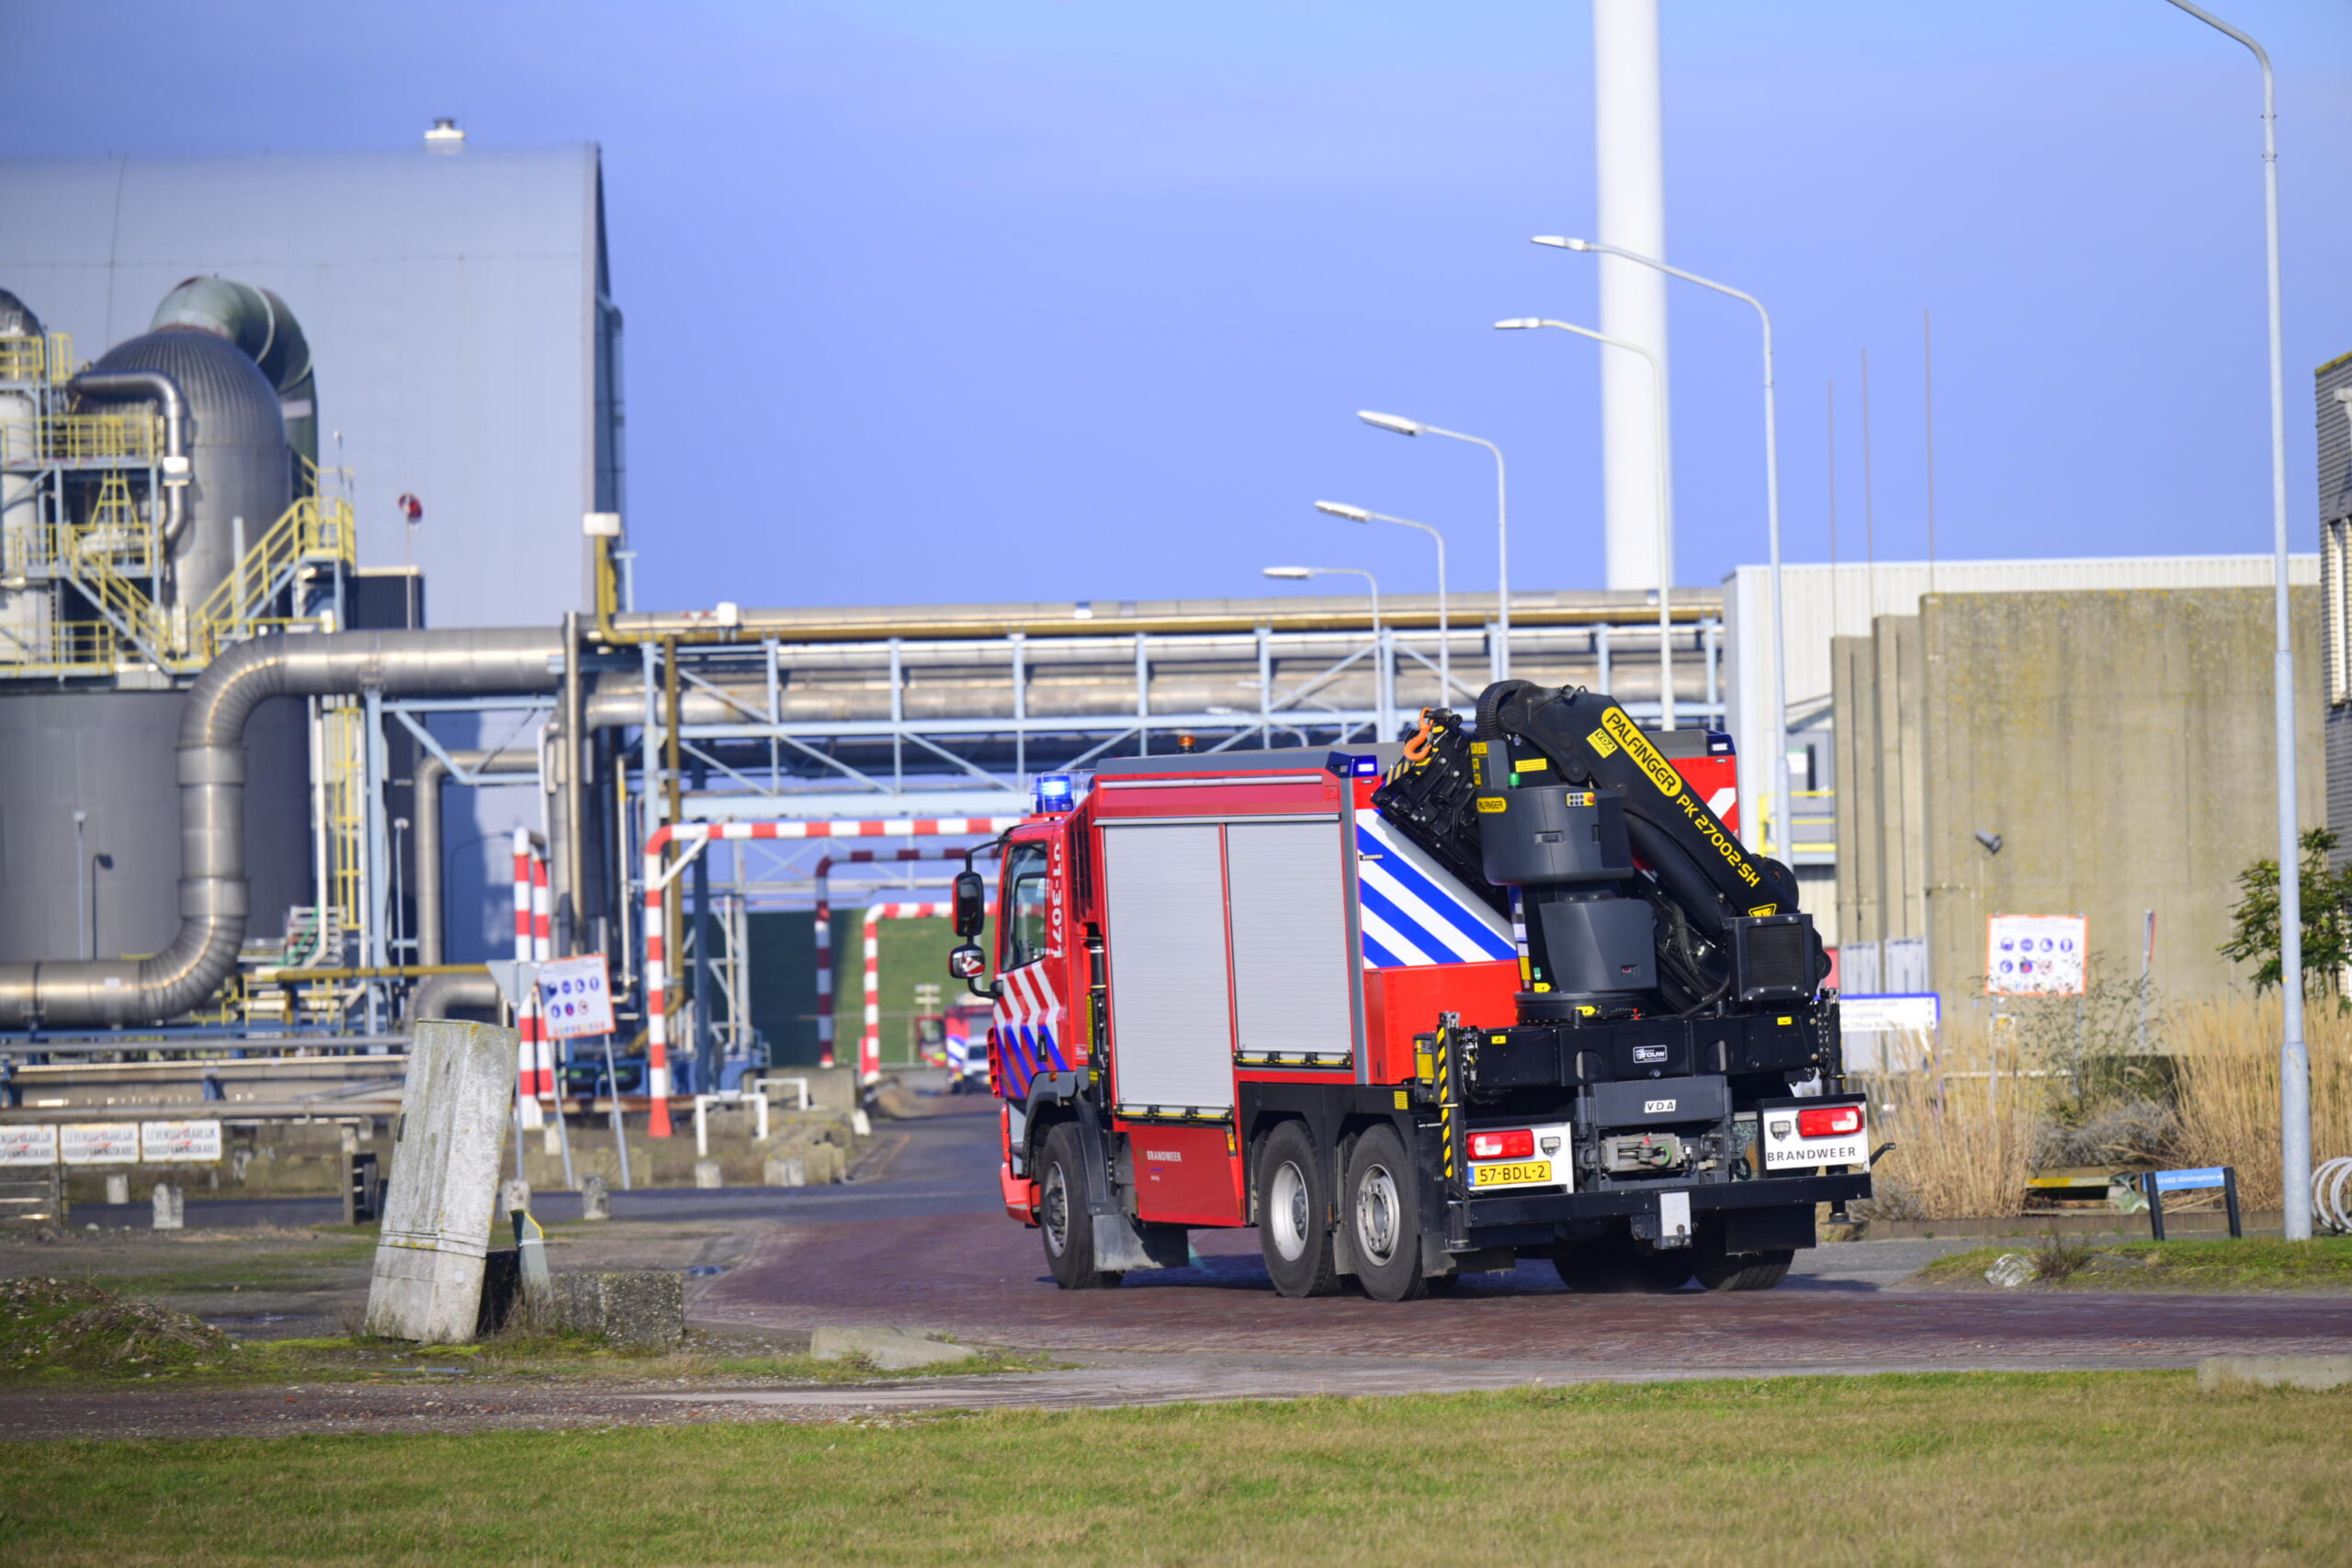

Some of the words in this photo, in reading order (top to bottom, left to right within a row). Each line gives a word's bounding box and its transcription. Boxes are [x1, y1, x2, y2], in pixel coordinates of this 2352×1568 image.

[1606, 712, 1677, 792] PALFINGER
[1676, 794, 1699, 818] PK
[1646, 1101, 1674, 1111] VDA
[1767, 1146, 1856, 1162] BRANDWEER
[1480, 1165, 1545, 1182] 57-BDL-2
